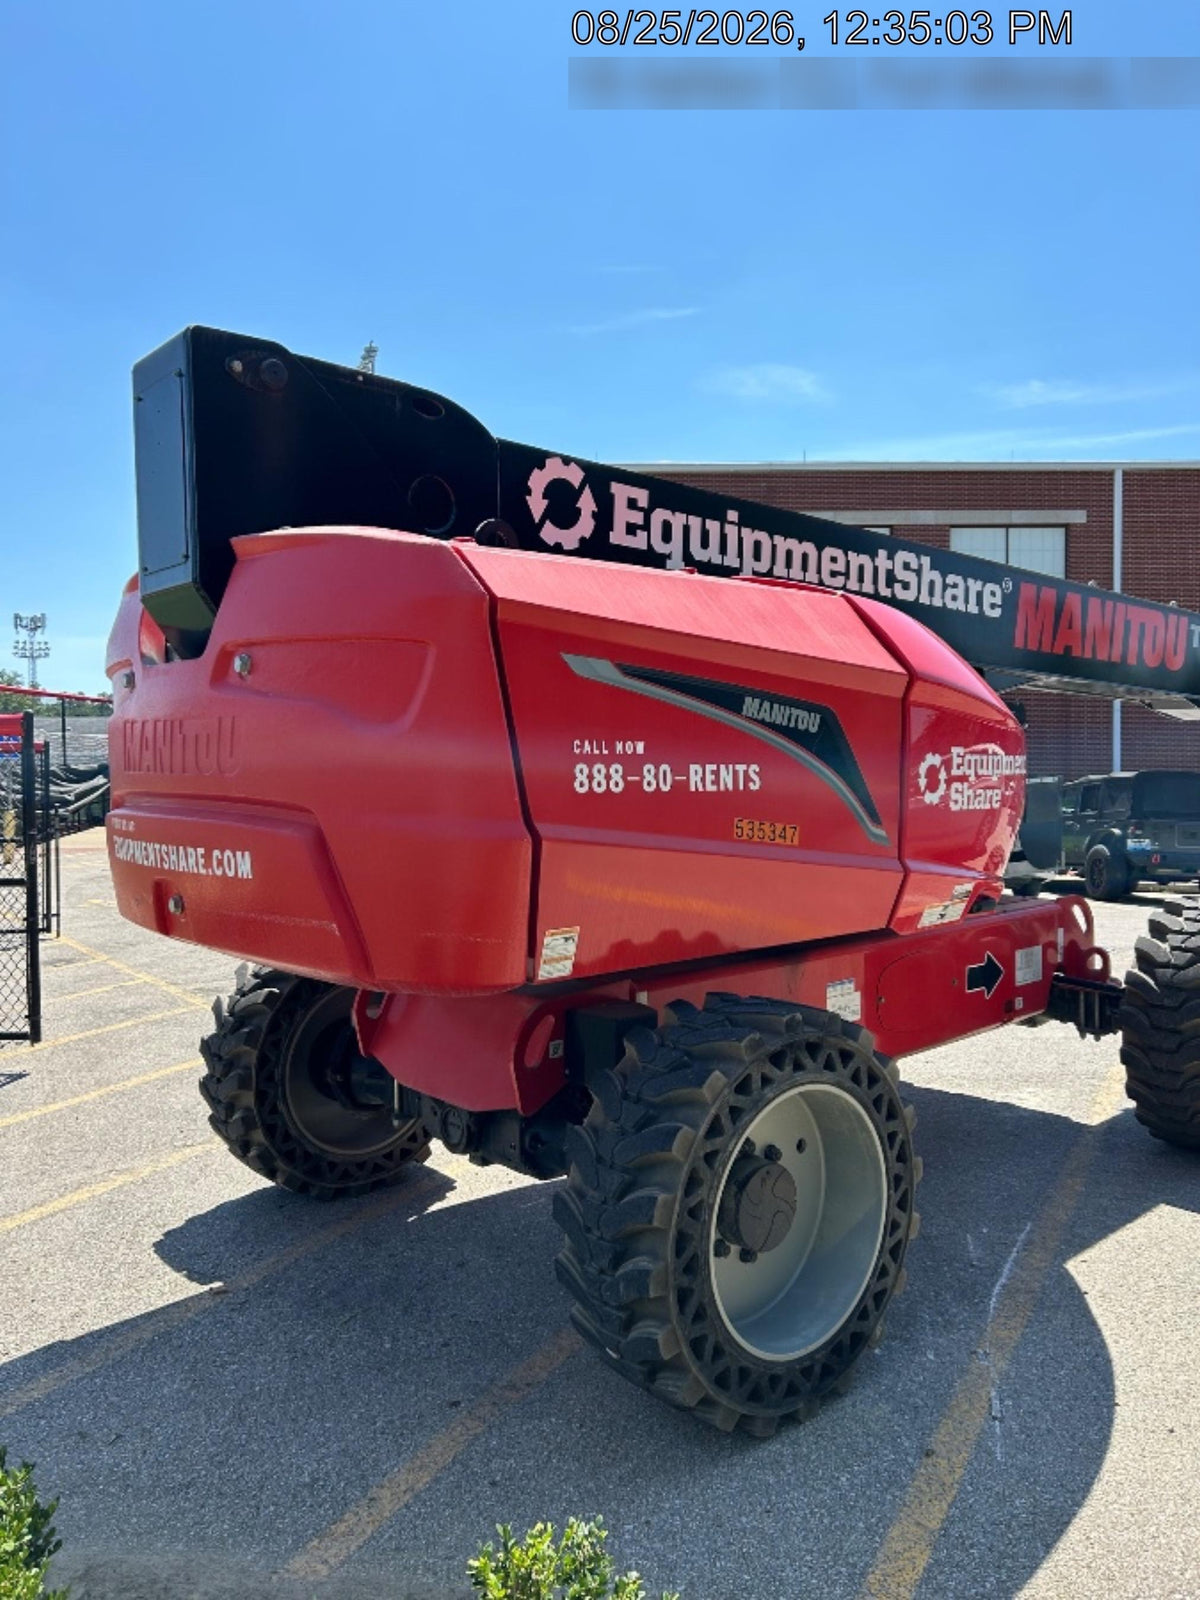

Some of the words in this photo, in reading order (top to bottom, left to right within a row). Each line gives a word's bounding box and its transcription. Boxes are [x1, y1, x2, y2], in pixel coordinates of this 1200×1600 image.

[1014, 582, 1189, 671] MANITOU
[741, 696, 821, 733] MANITOU
[123, 717, 240, 776] MANITOU
[573, 739, 608, 755] CALL
[616, 740, 645, 755] NOW
[573, 763, 762, 793] 888-80-RENTS
[949, 782, 1001, 811] Share
[735, 818, 797, 843] 535347
